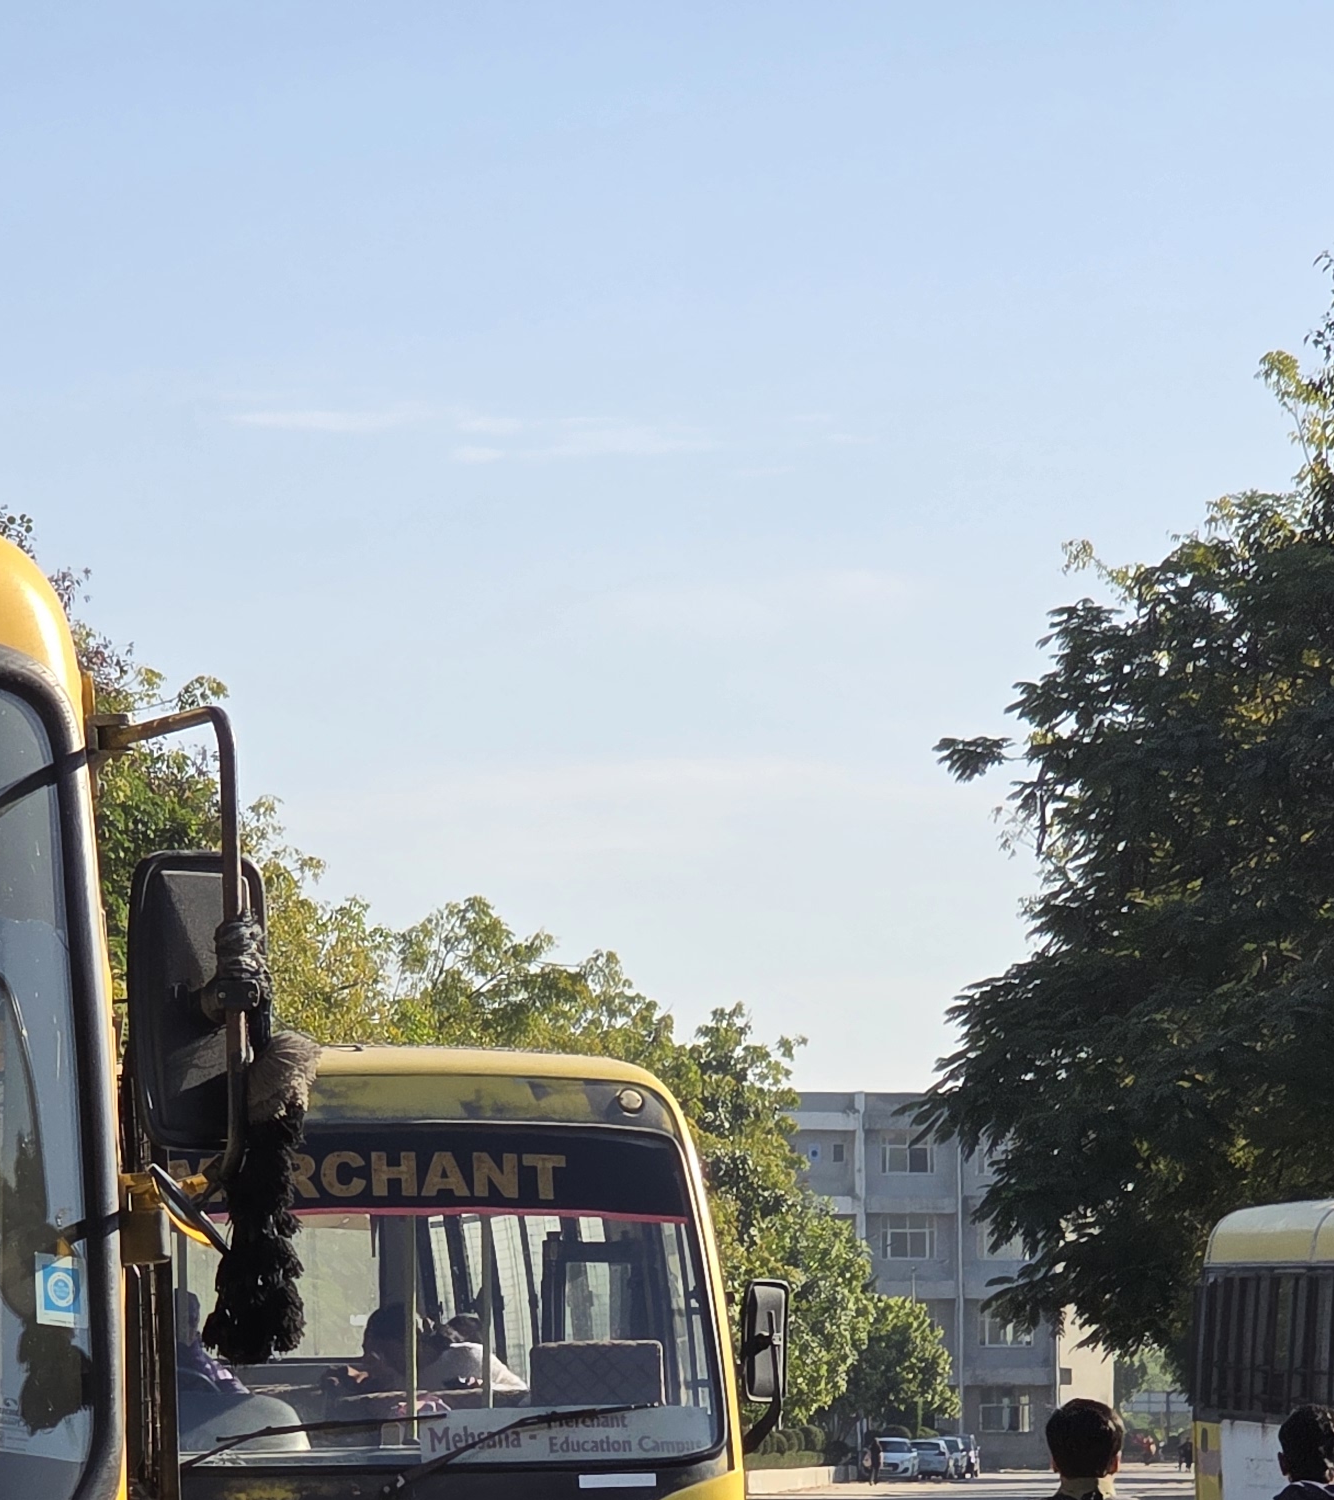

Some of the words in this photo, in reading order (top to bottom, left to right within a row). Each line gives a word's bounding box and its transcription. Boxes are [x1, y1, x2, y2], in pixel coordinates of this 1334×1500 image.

[168, 1150, 567, 1204] RCHANT
[427, 1425, 522, 1452] Mehsana
[548, 1435, 633, 1454] Education
